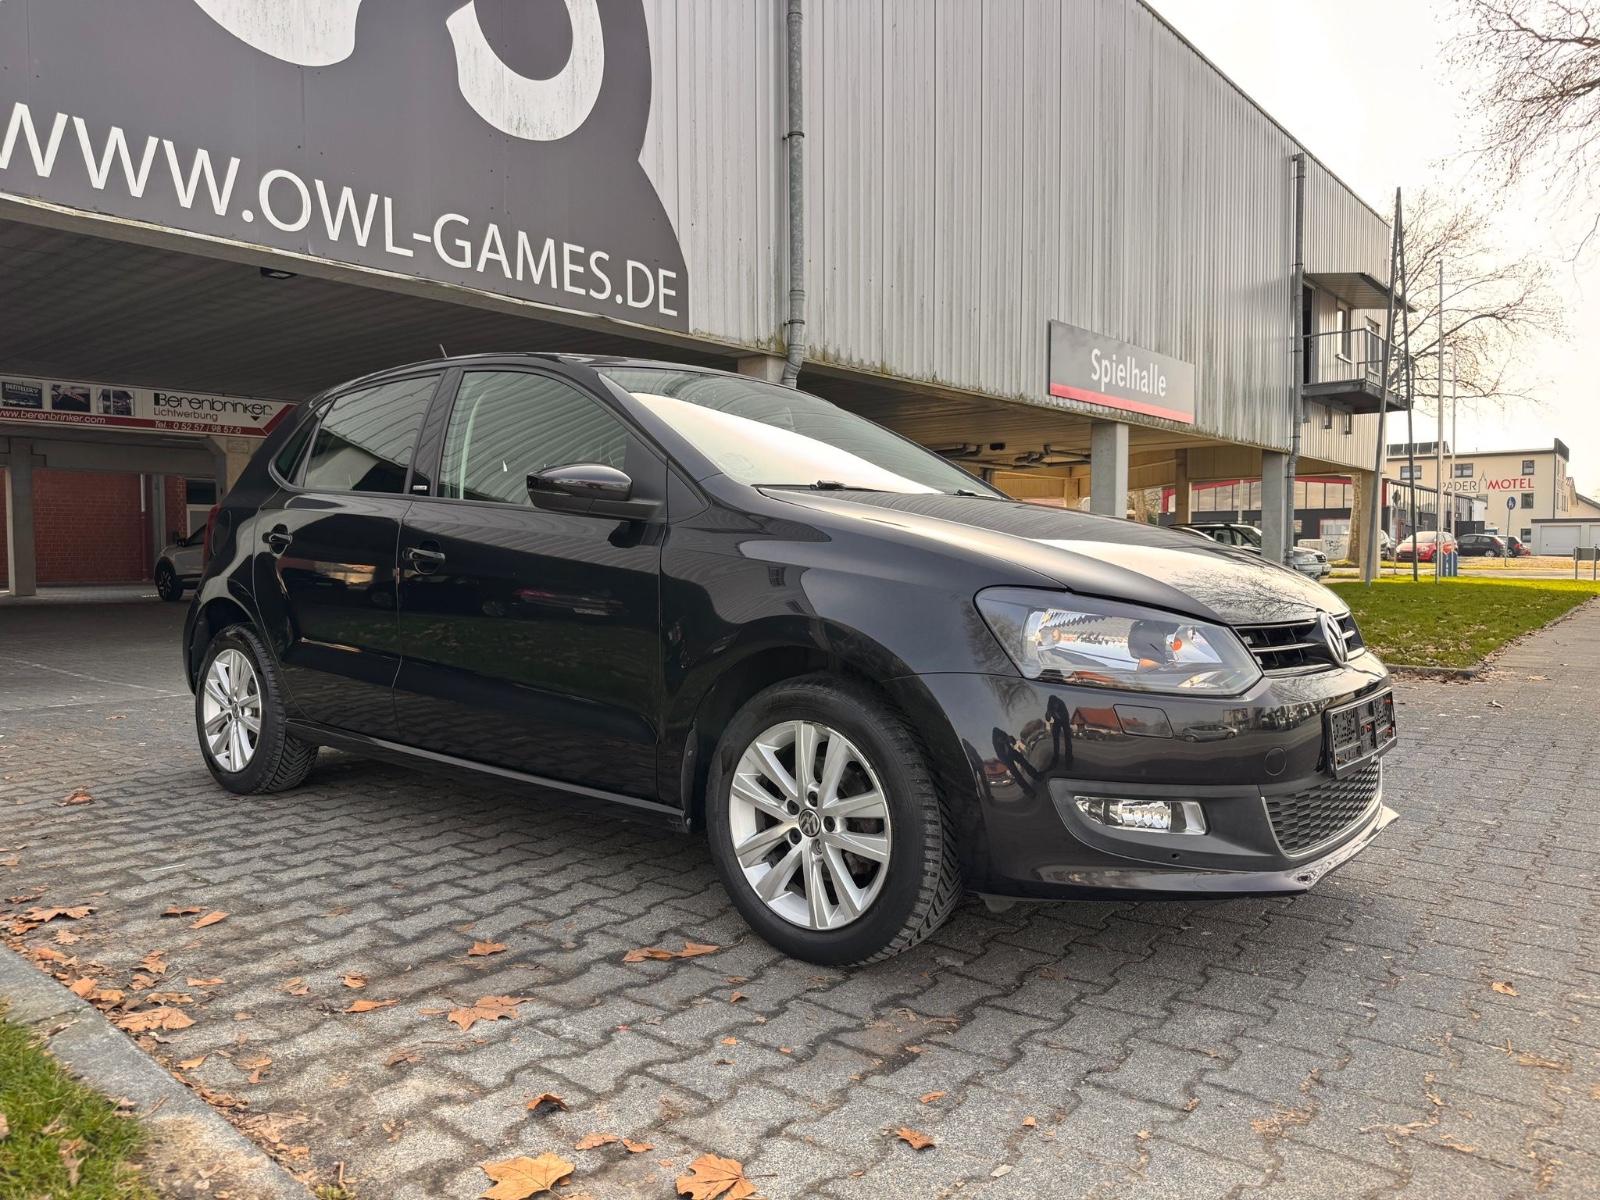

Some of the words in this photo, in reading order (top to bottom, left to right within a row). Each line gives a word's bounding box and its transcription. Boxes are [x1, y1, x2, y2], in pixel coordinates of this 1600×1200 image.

[0, 102, 678, 317] WWW.OWL-GAMES.DE
[1091, 348, 1167, 396] Spielhalle
[153, 407, 219, 422] Lichtwerbung
[154, 392, 273, 416] Berenbrinker
[1487, 478, 1535, 490] MOTEL
